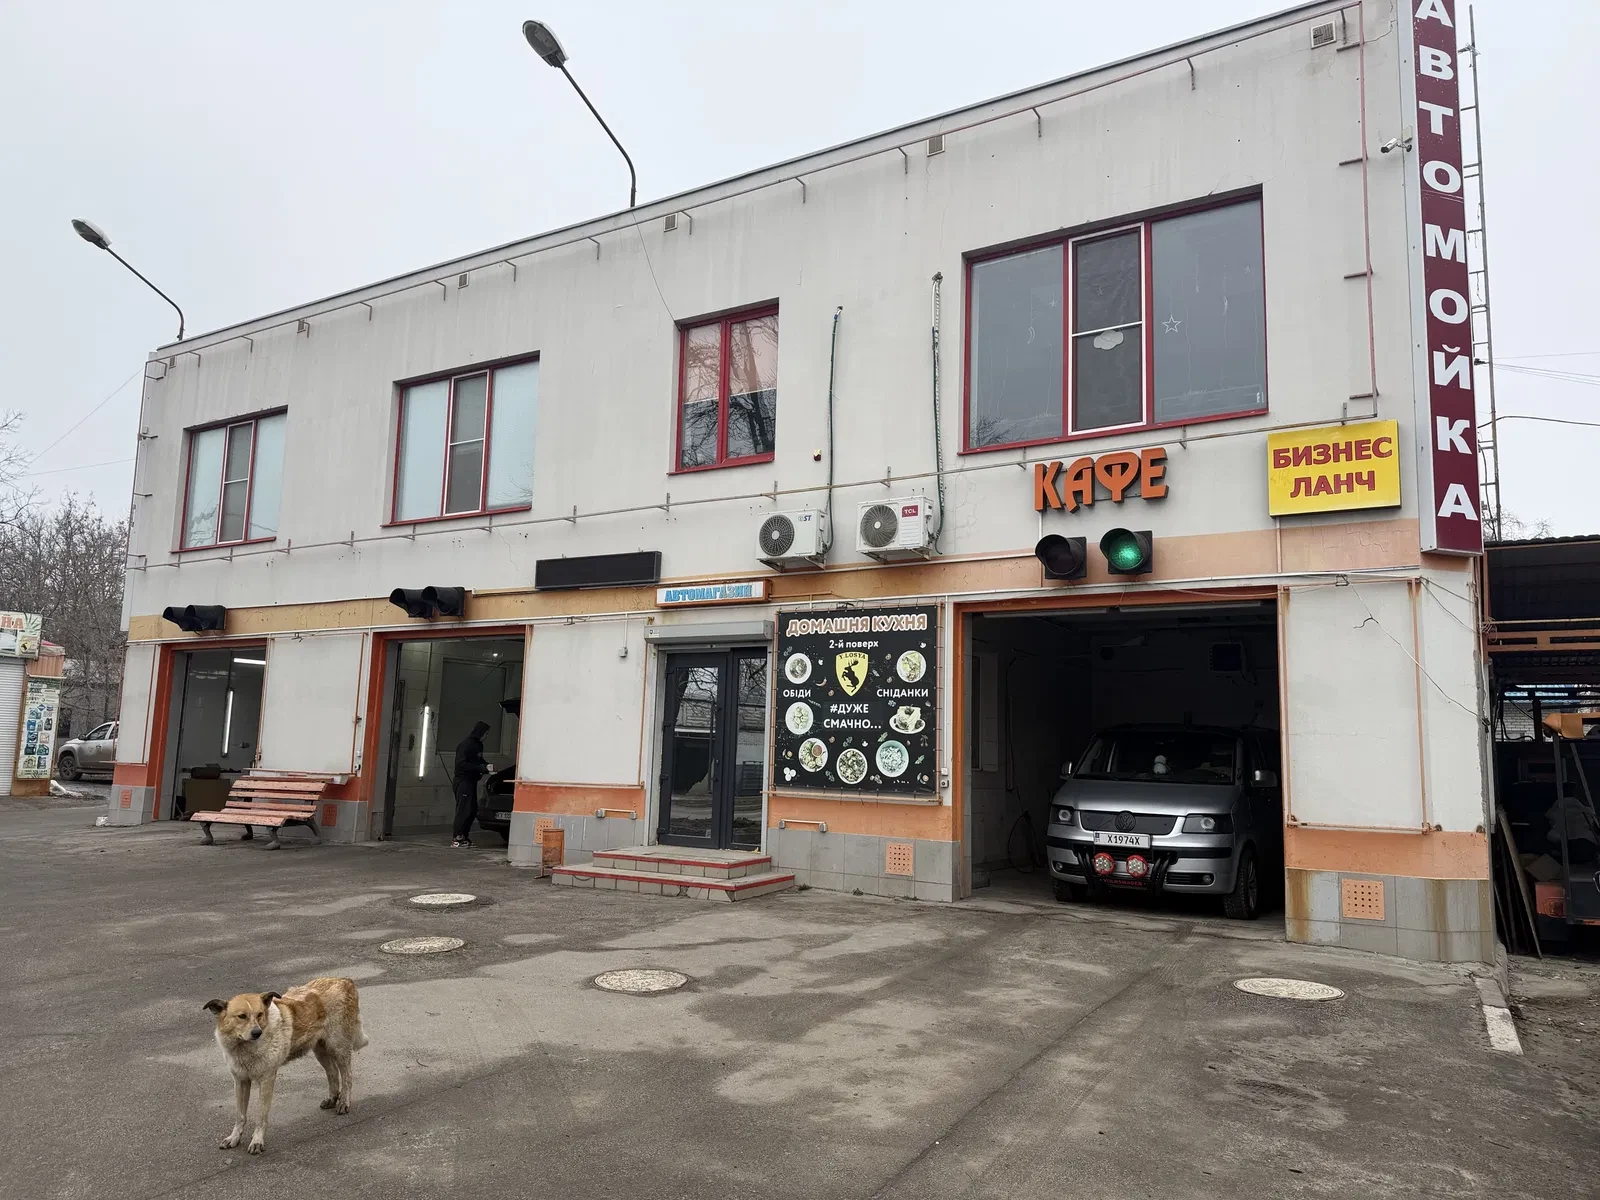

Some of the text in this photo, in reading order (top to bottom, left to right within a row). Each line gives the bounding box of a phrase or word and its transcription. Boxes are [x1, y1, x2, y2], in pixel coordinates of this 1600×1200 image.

[1415, 0, 1478, 521] АВТОМОЙКА
[1273, 437, 1392, 469] БИЗНЕС
[1034, 447, 1169, 514] КАФЕ
[1290, 470, 1375, 498] ЛАНЧ
[664, 584, 753, 602] АВТОМАГАЗИН
[786, 613, 927, 637] ДОМАШНЯ КУХНЯ
[829, 639, 879, 649] 2-й поверх
[783, 689, 811, 698] ОБІДИ
[876, 688, 929, 698] СНІДАНКИ
[830, 703, 869, 715] #ДУЖЕ
